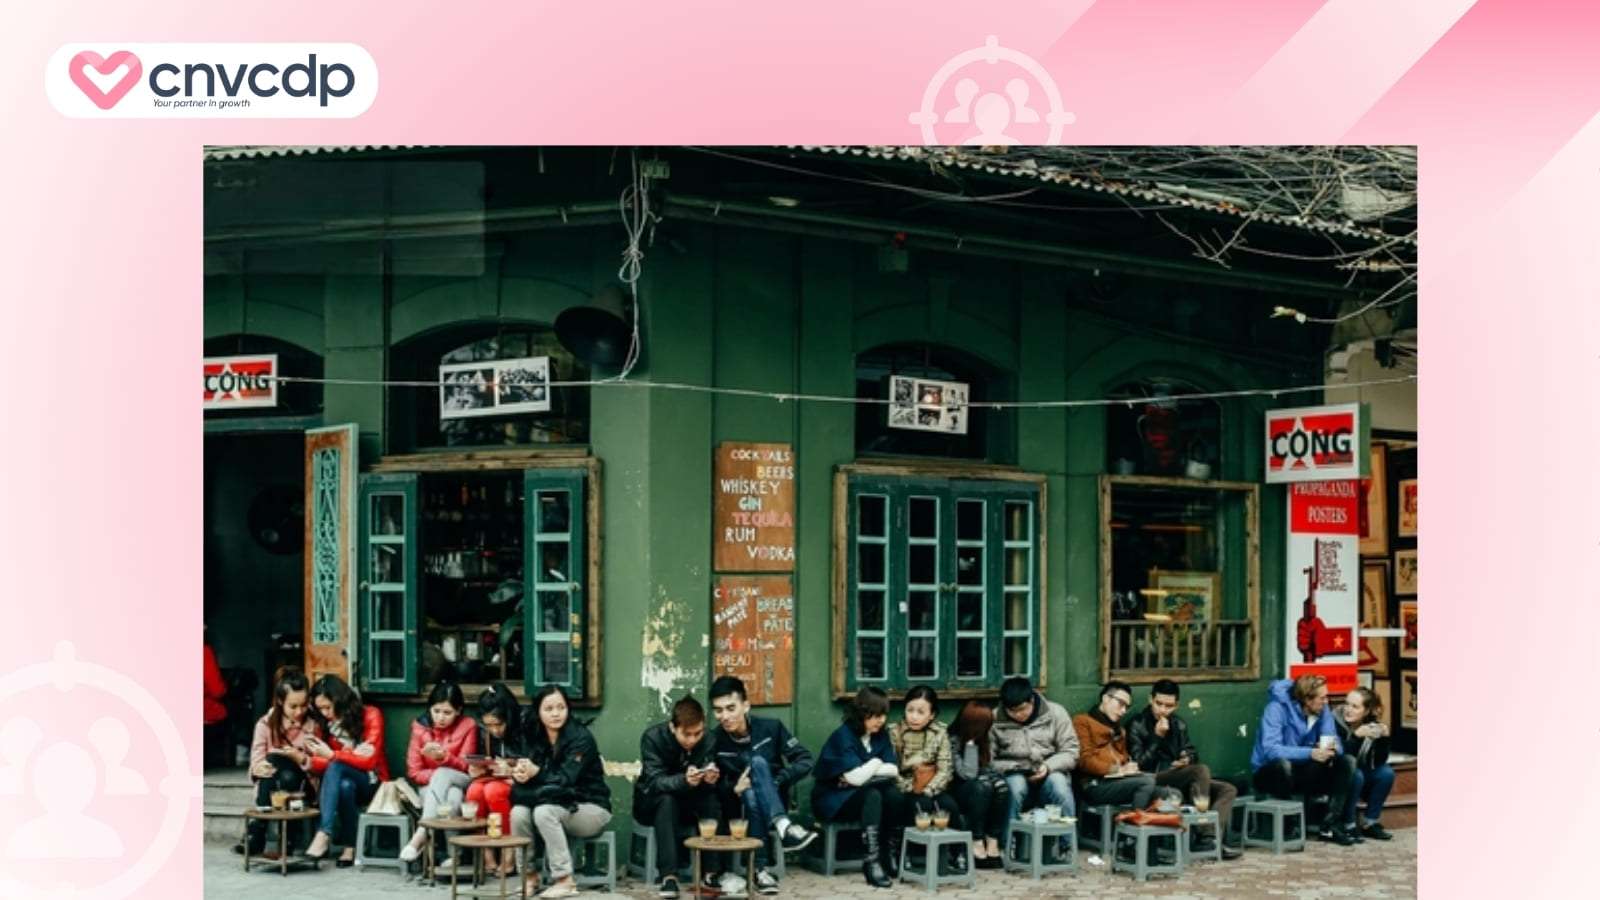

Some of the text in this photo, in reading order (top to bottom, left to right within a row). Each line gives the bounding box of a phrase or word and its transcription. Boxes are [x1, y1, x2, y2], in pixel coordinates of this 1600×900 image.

[756, 466, 794, 479] BEERS
[1294, 481, 1356, 497] PROPAGANDA
[1308, 506, 1348, 523] POSTERS
[725, 527, 756, 543] RUM
[747, 545, 795, 561] VODKA
